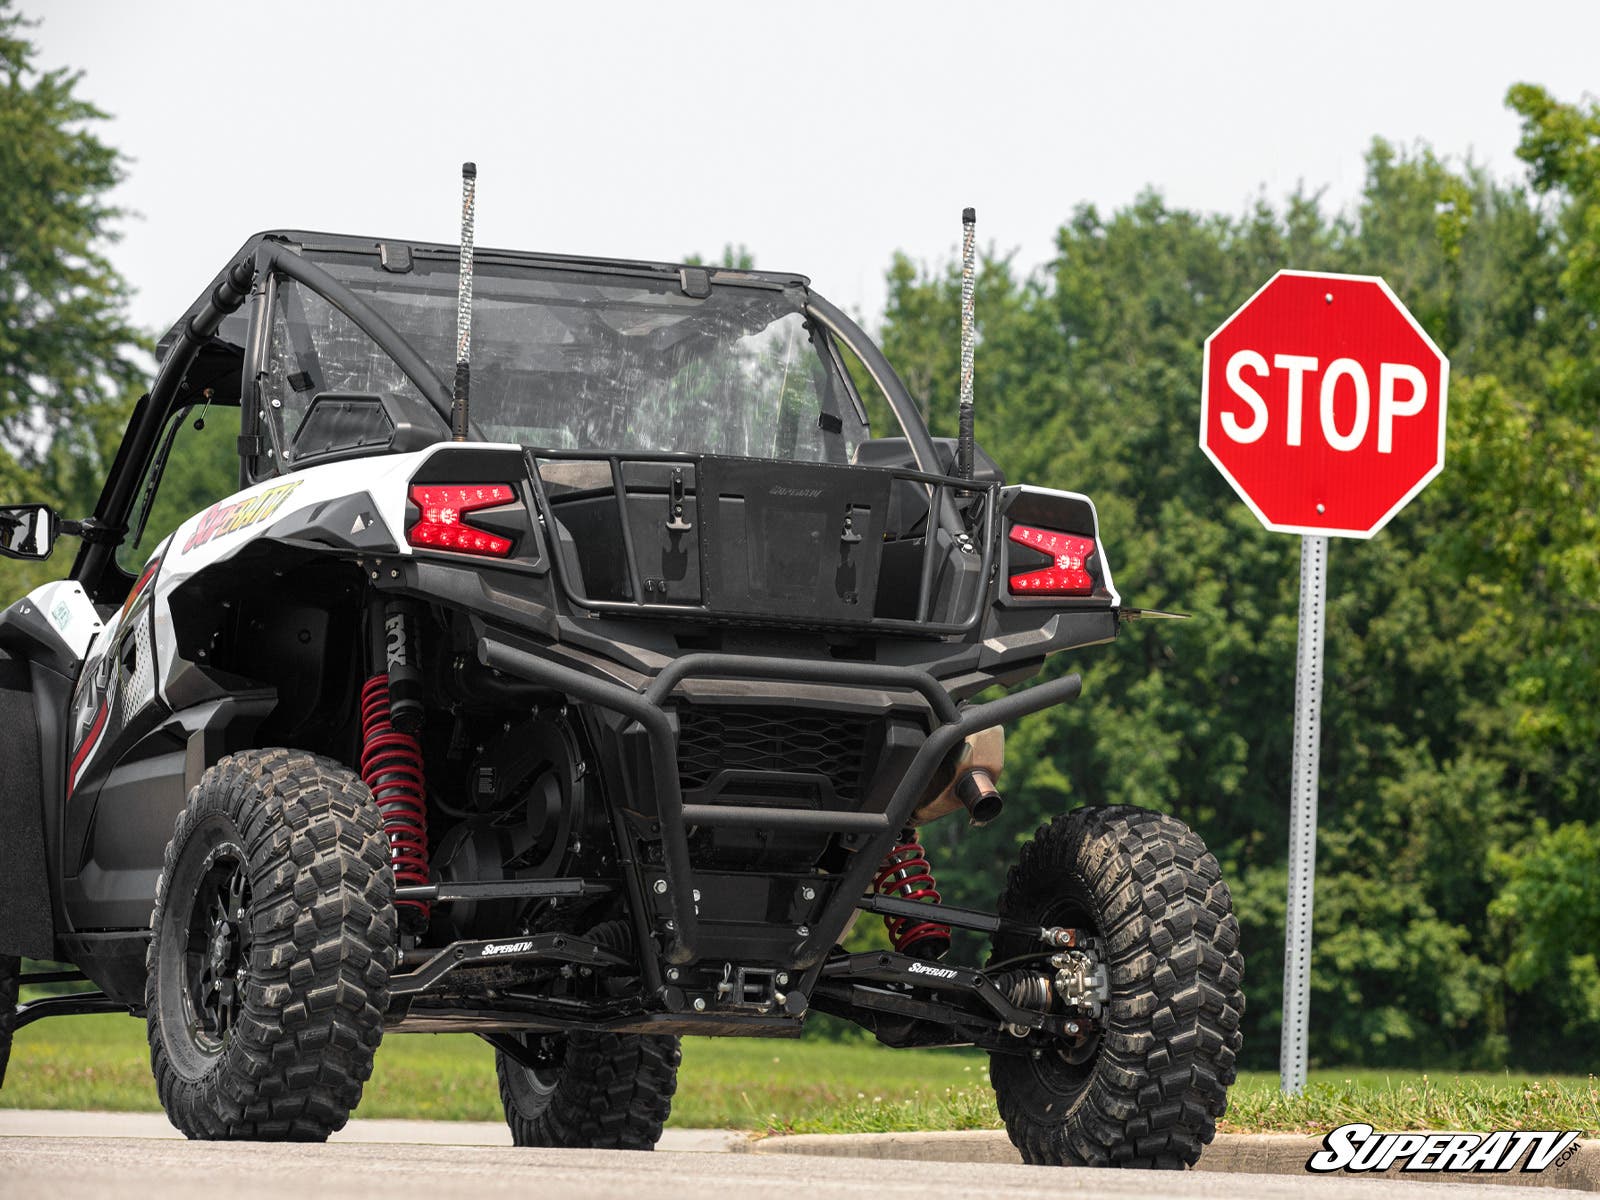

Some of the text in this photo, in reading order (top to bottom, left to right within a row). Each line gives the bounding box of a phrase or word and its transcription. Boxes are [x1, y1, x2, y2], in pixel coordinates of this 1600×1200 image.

[1220, 349, 1428, 454] STOP
[181, 479, 304, 555] SUPERATV
[385, 613, 407, 673] FOX
[481, 941, 533, 956] SUPERATV
[908, 962, 958, 979] SUPERATV
